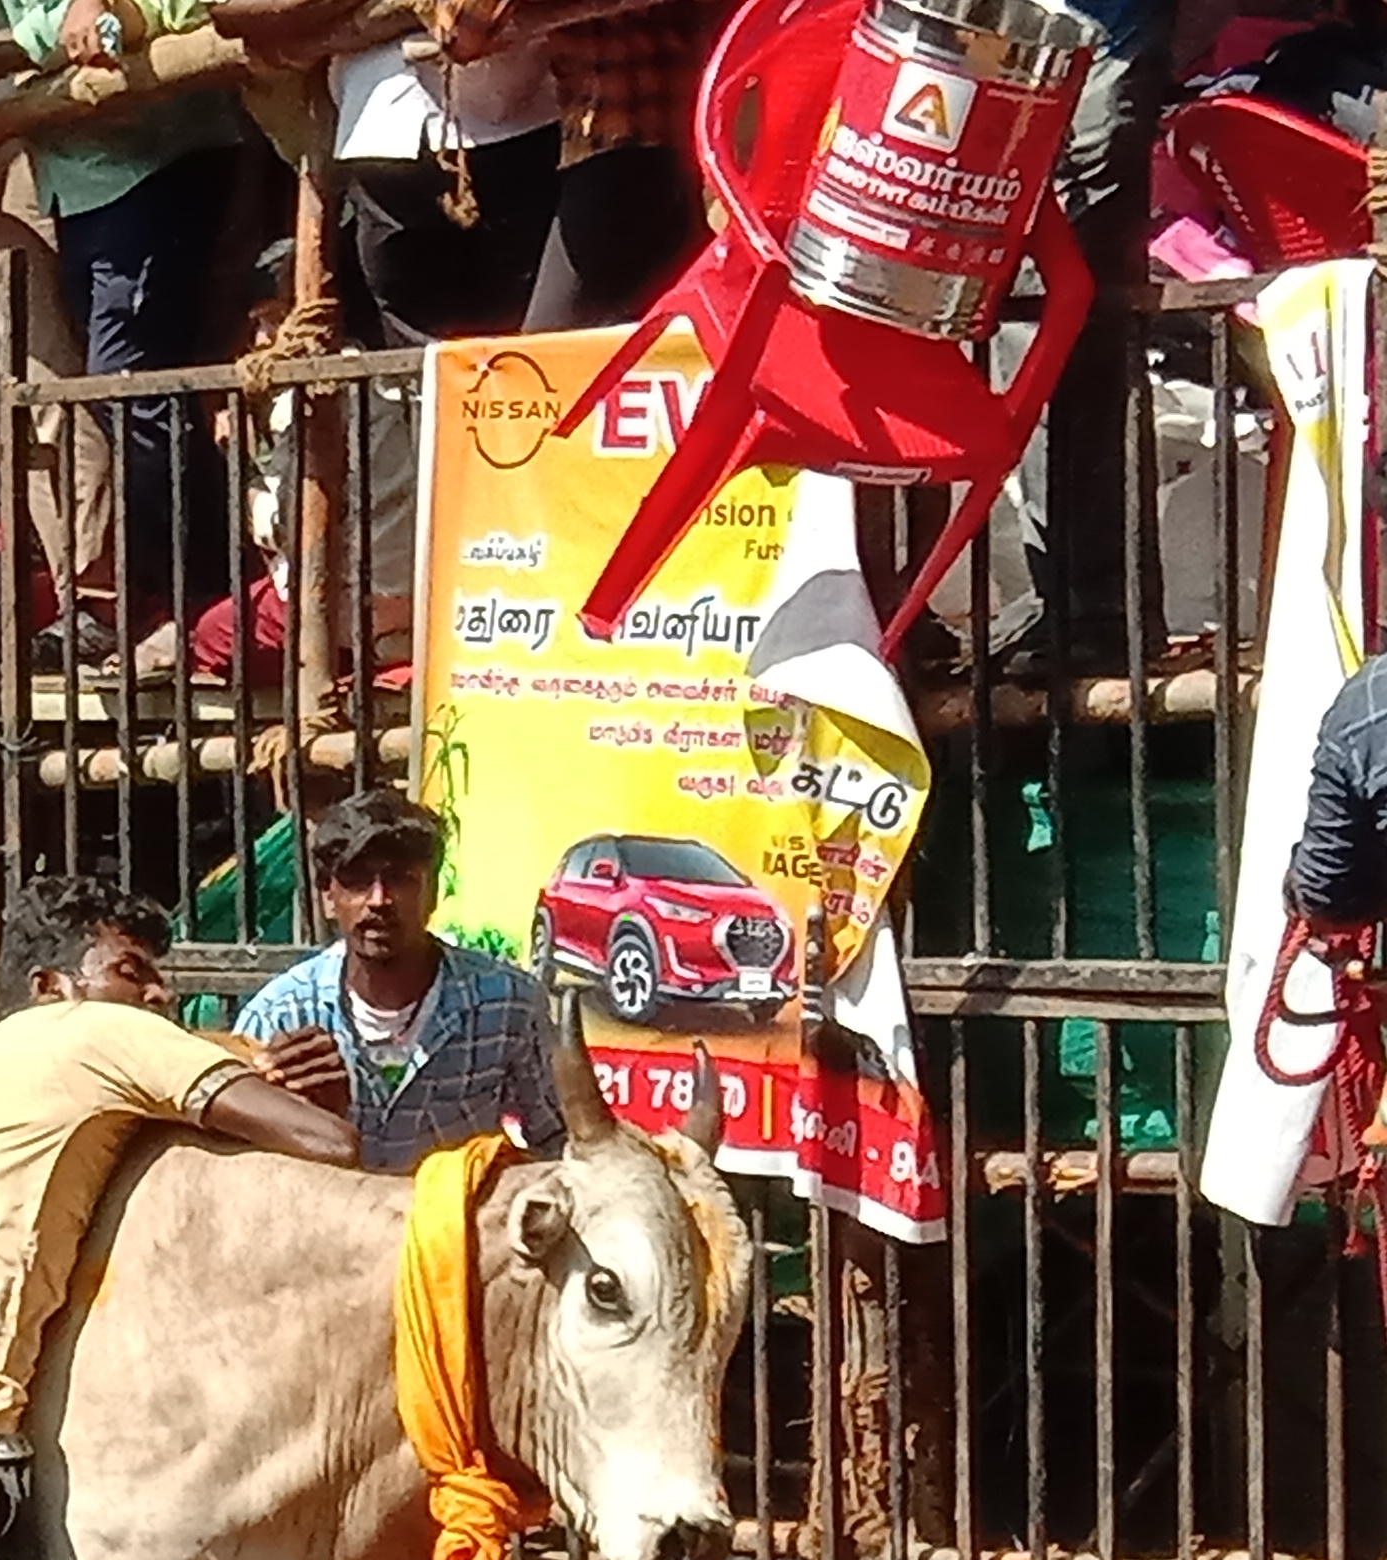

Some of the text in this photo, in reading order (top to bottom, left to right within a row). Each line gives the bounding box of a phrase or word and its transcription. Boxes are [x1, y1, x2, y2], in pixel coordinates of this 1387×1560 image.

[462, 400, 562, 420] NISSAN
[576, 595, 762, 656] வனியா
[791, 763, 909, 830] கட்டு
